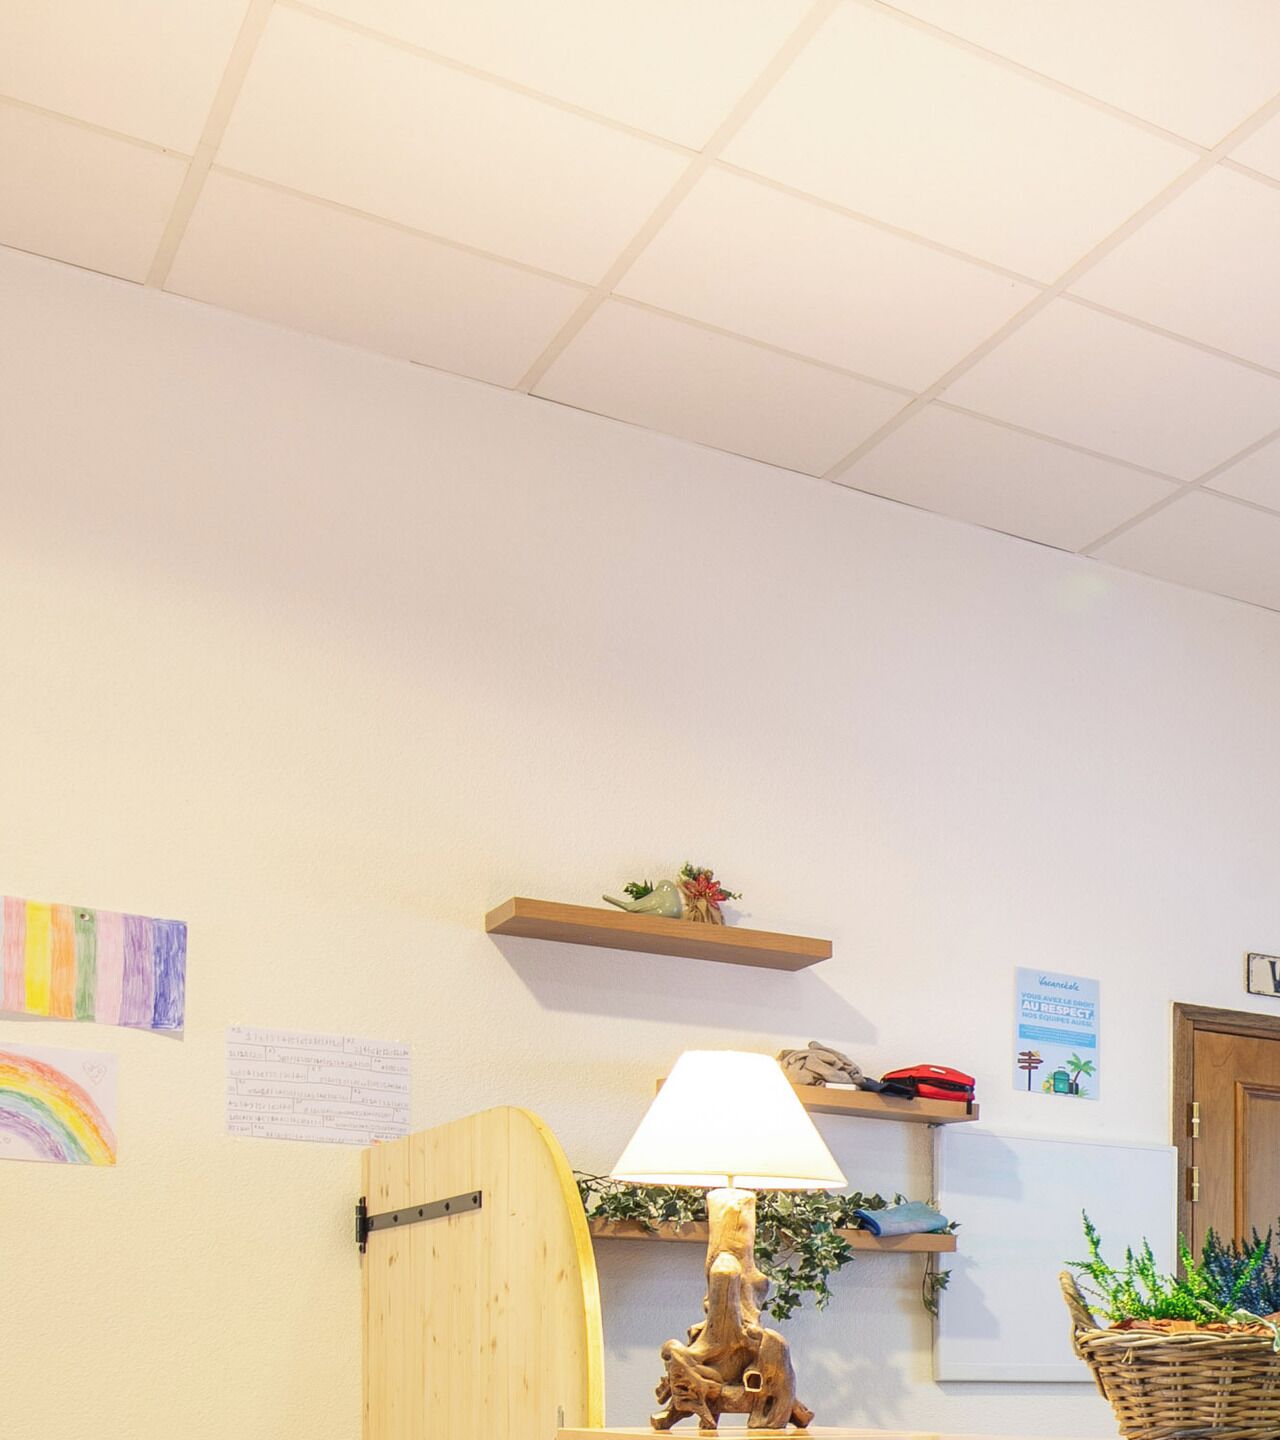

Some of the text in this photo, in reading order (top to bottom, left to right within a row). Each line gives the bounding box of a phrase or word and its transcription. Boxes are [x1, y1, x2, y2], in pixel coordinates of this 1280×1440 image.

[1021, 992, 1041, 1000] VOUS
[1043, 995, 1063, 1003] AVEZ
[1073, 999, 1095, 1008] DROIT
[1022, 1001, 1039, 1011] AU
[1022, 1011, 1038, 1019] NOS
